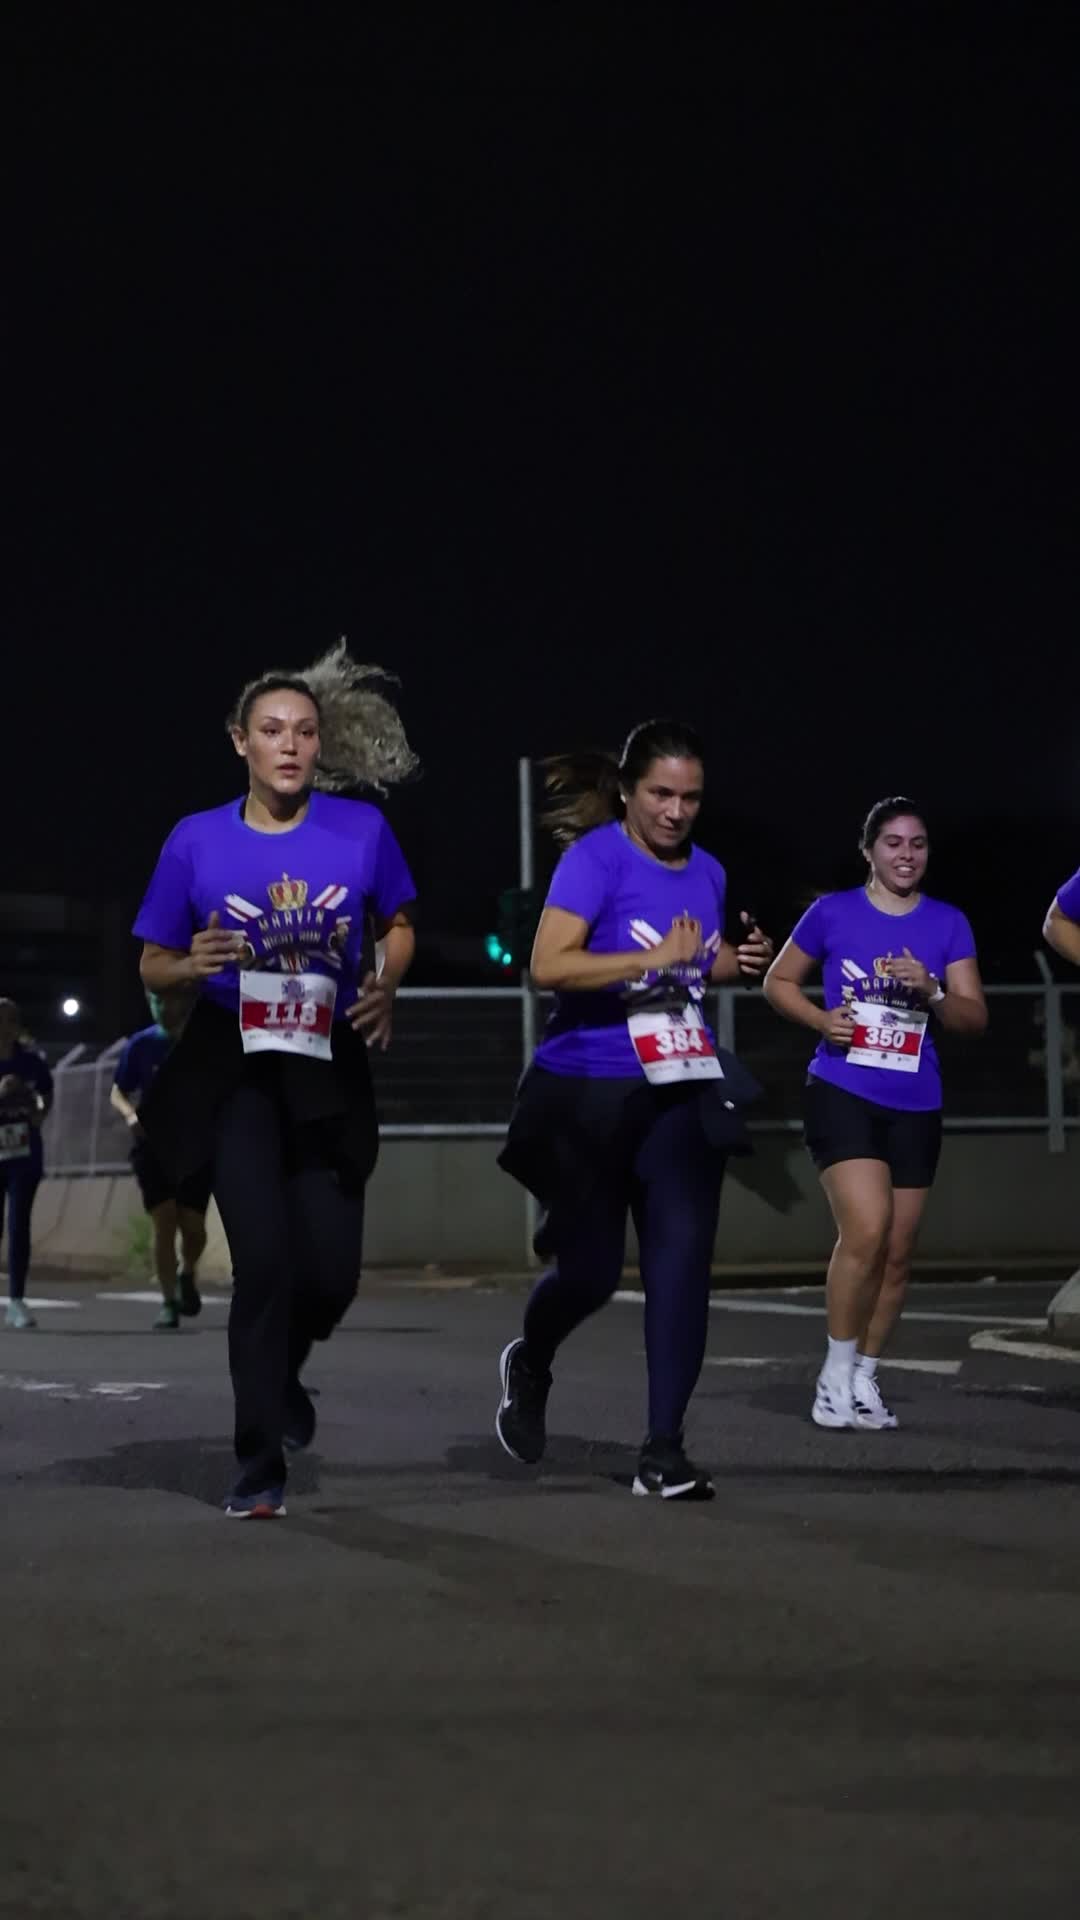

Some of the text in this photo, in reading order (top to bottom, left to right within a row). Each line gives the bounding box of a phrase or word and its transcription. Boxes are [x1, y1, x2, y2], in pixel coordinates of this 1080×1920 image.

[257, 909, 325, 932] MARVIN
[264, 1001, 318, 1026] 118
[655, 1029, 704, 1055] 384
[864, 1027, 906, 1049] 350
